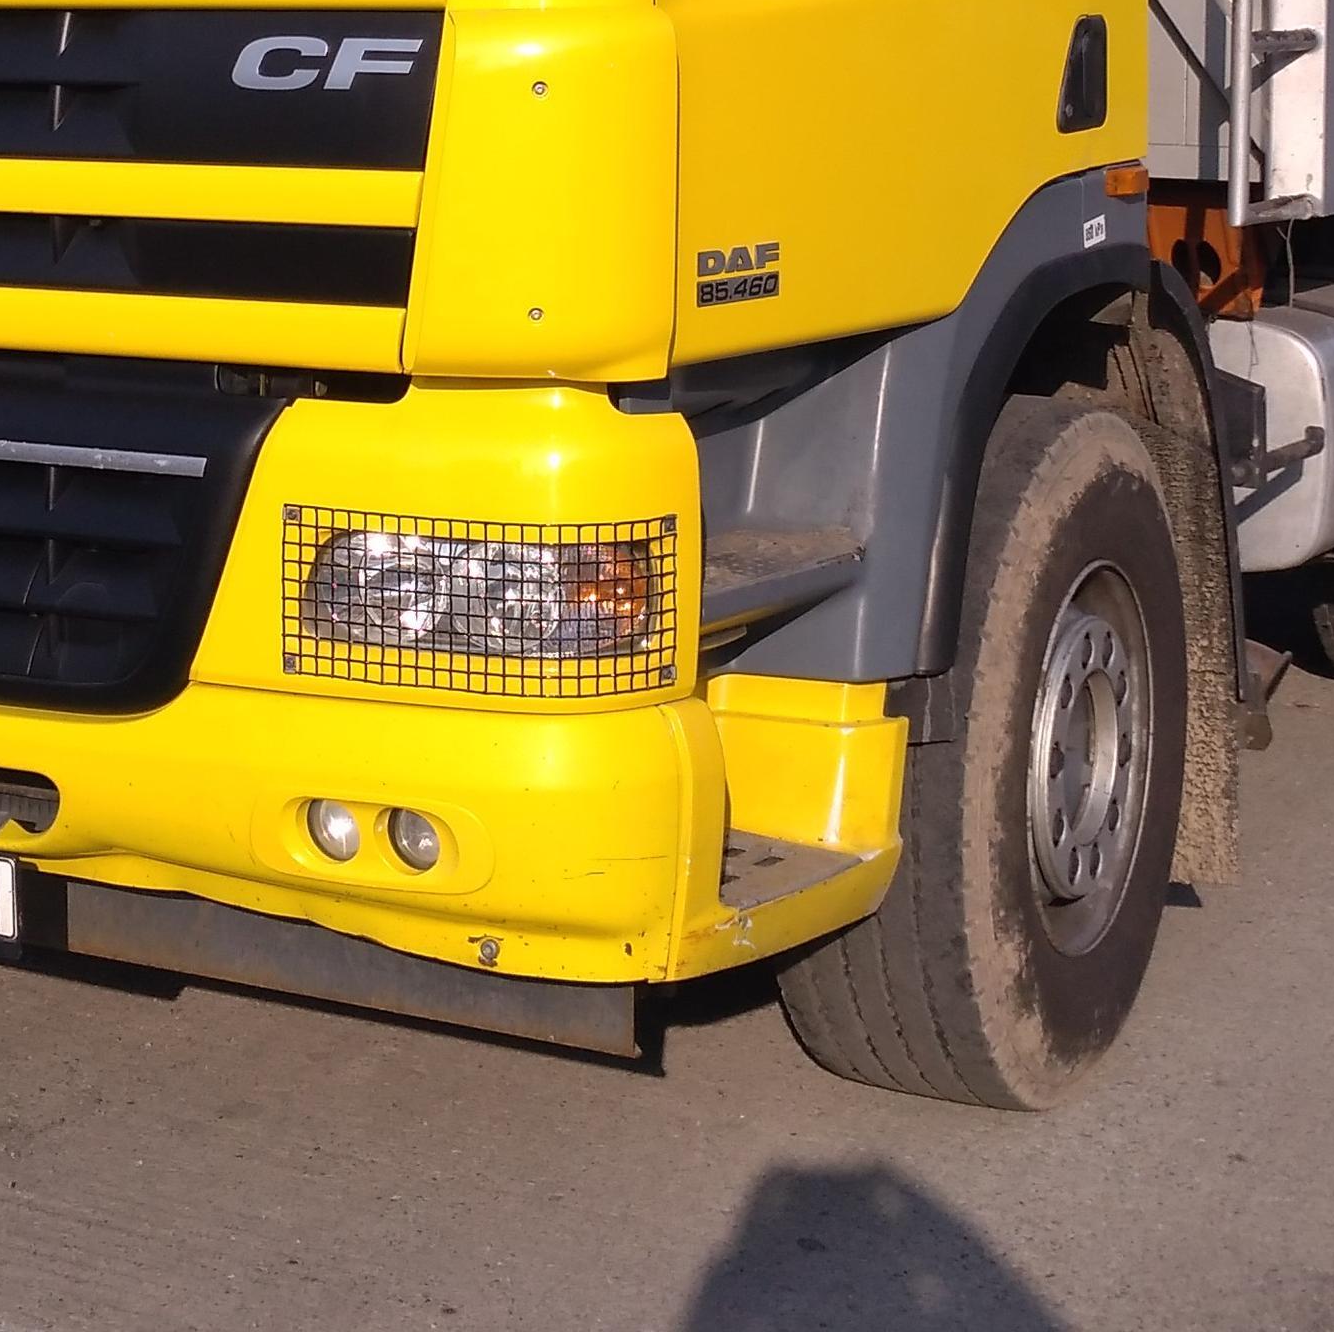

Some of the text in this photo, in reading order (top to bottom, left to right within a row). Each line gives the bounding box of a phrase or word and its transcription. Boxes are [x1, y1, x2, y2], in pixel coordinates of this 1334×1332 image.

[230, 36, 423, 91] CF
[697, 242, 780, 277] DAF
[699, 274, 779, 304] 85.460
